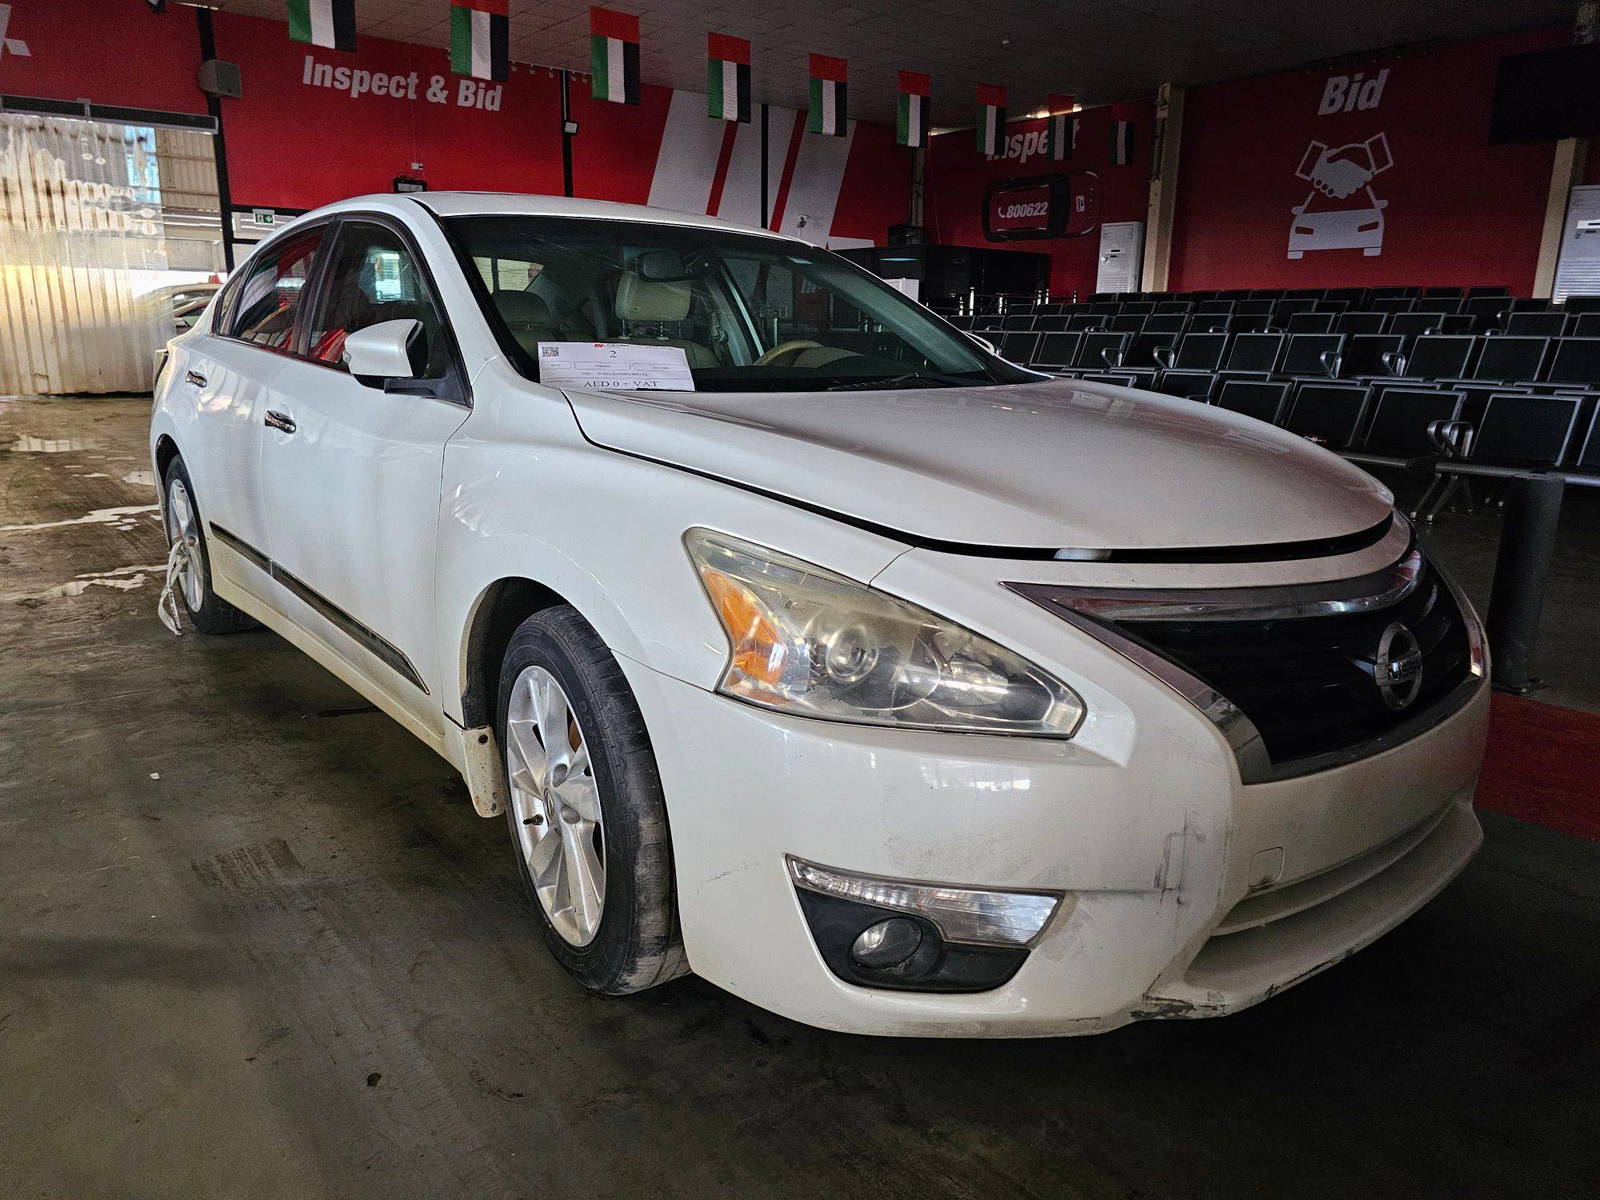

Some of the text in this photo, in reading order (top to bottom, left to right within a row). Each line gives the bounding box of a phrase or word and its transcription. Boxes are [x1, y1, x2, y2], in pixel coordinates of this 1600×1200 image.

[303, 55, 503, 112] Inspect & Bid
[1317, 68, 1390, 116] Bid
[984, 119, 1080, 164] spet
[1006, 202, 1048, 218] 800622
[609, 350, 617, 359] 2
